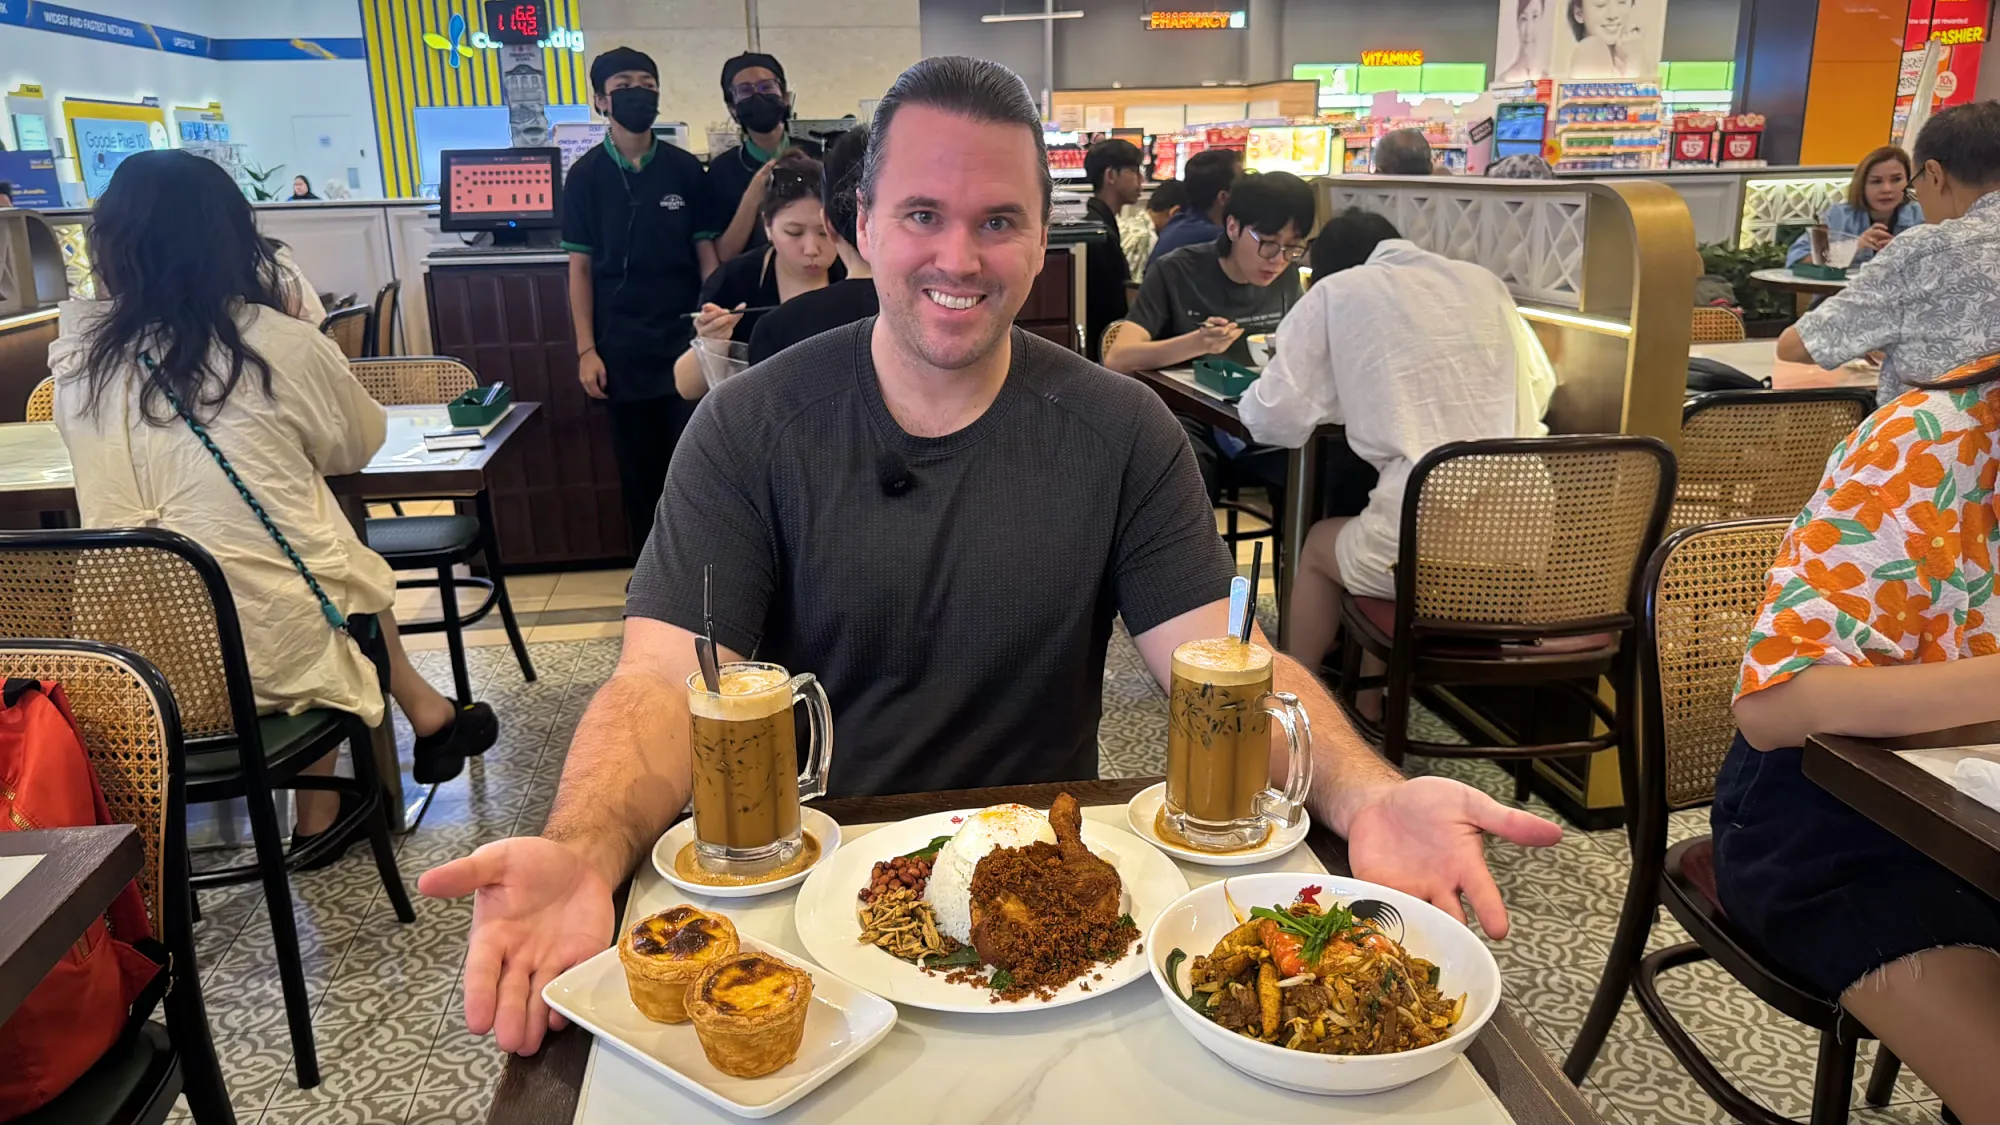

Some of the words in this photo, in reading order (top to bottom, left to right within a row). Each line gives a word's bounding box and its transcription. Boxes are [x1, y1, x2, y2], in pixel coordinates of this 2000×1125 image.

[43, 11, 69, 26] WIDEST
[69, 16, 84, 29] AND
[84, 18, 107, 33] FASTEST
[107, 23, 135, 38] NETWORK
[1151, 12, 1229, 28] PHARMACY
[1930, 26, 1983, 45] CASHIER
[1361, 49, 1423, 66] VITAMINS
[86, 131, 117, 149] Google
[117, 132, 136, 149] Pixel
